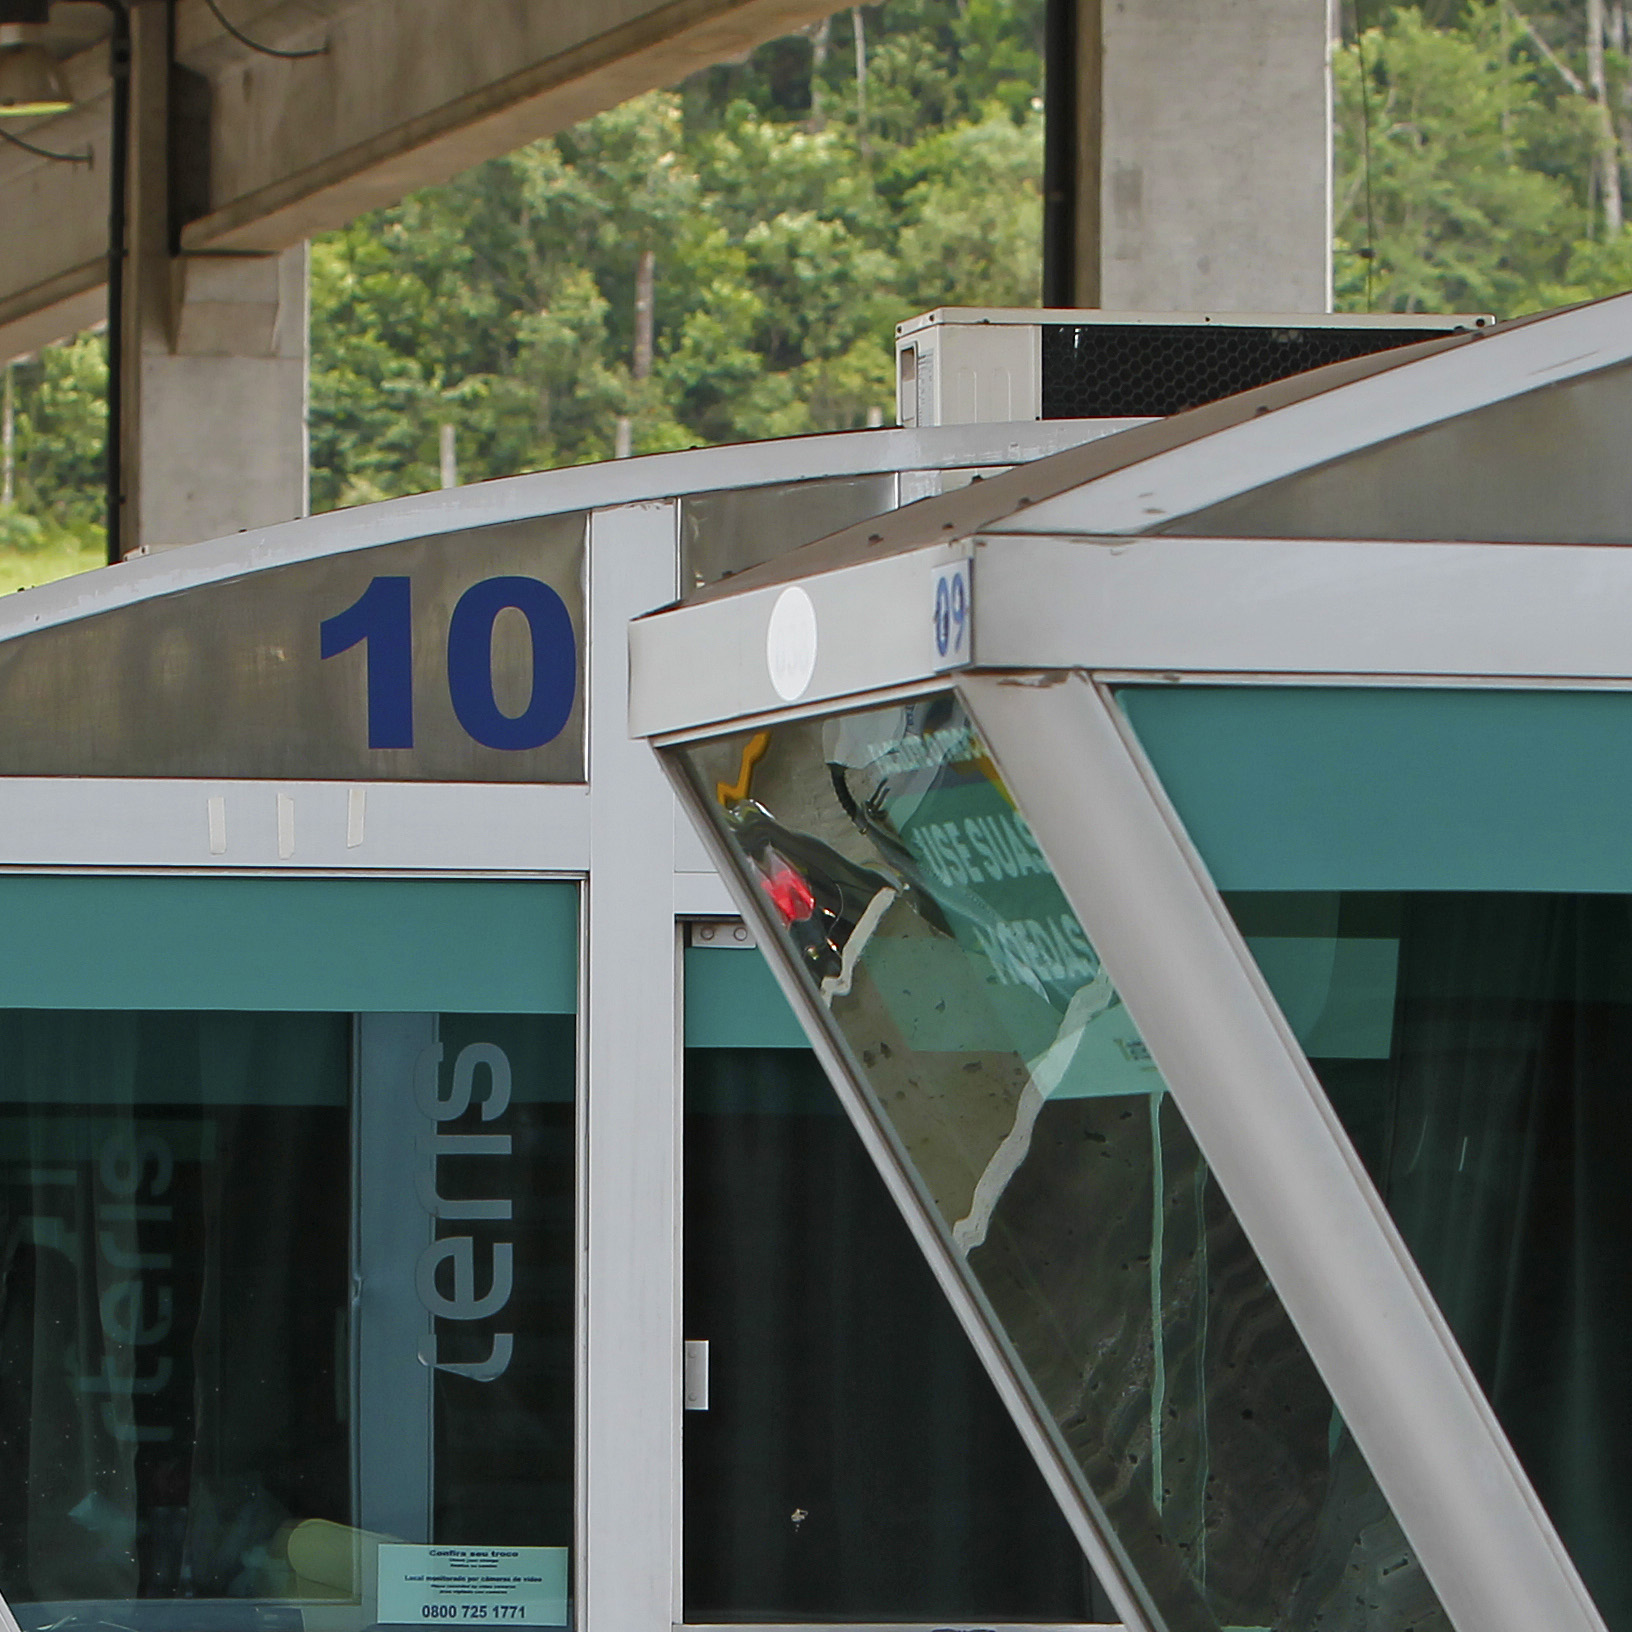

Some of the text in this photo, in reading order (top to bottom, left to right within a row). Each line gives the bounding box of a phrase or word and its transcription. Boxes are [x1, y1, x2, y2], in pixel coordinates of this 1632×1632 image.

[319, 575, 578, 752] 10
[912, 821, 985, 888] USE
[422, 1605, 526, 1619] 0800 725 1771
